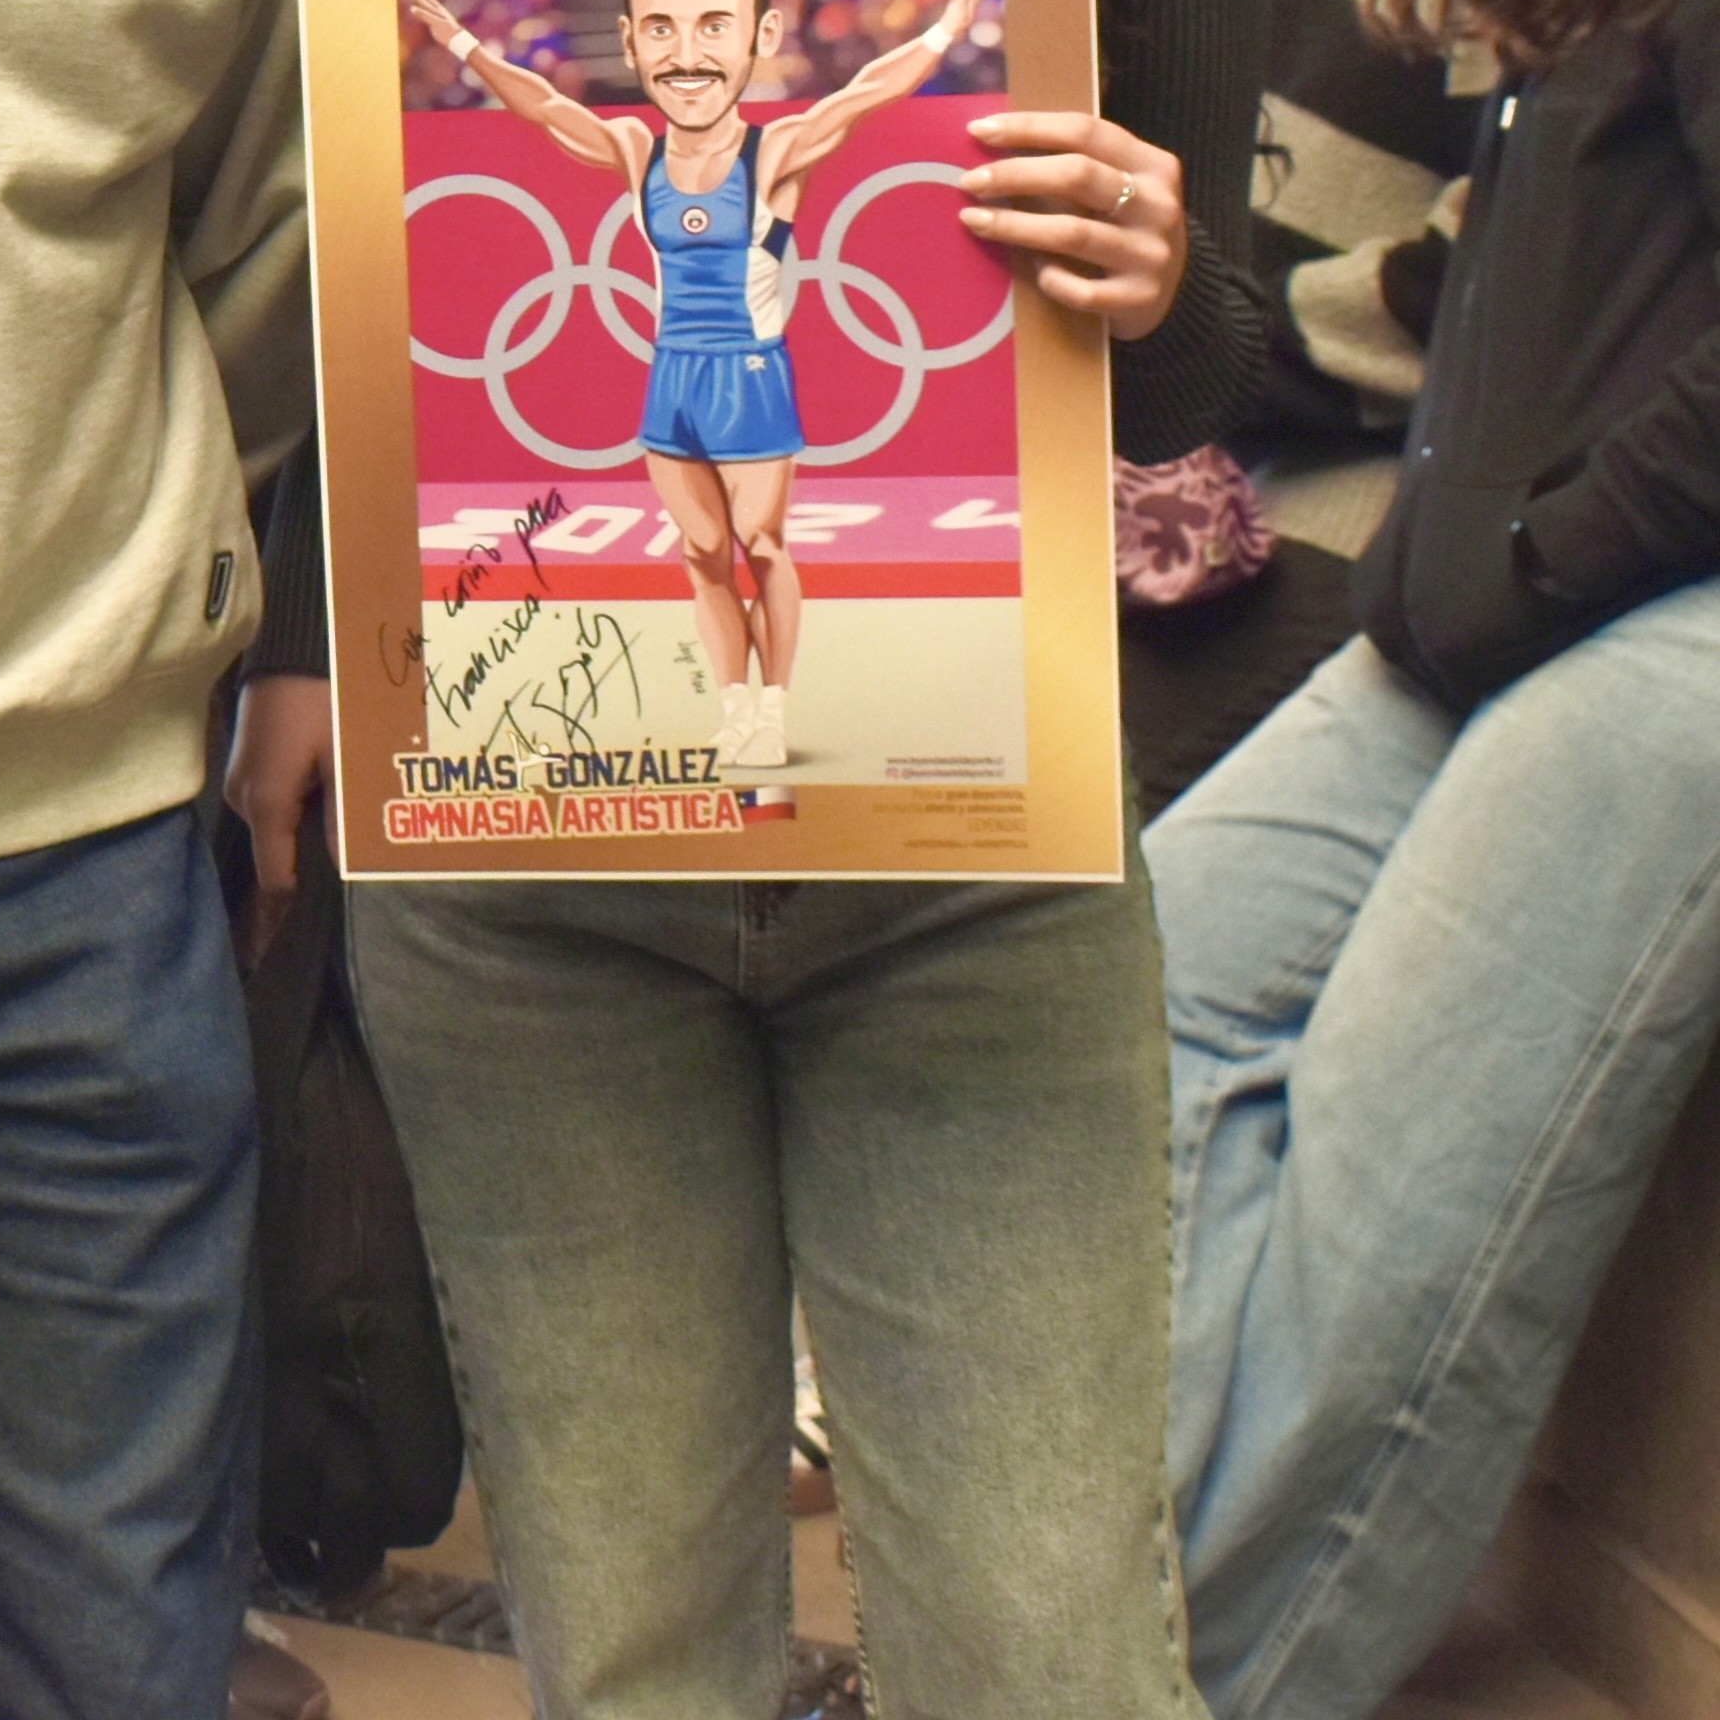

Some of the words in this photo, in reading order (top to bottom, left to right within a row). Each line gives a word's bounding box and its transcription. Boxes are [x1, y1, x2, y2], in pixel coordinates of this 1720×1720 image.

[400, 745, 517, 793] TOMÁS
[546, 738, 721, 788] GONZÁLEZ
[389, 798, 550, 839] GIMNASIA
[561, 787, 740, 831] ARTÍSTICA
